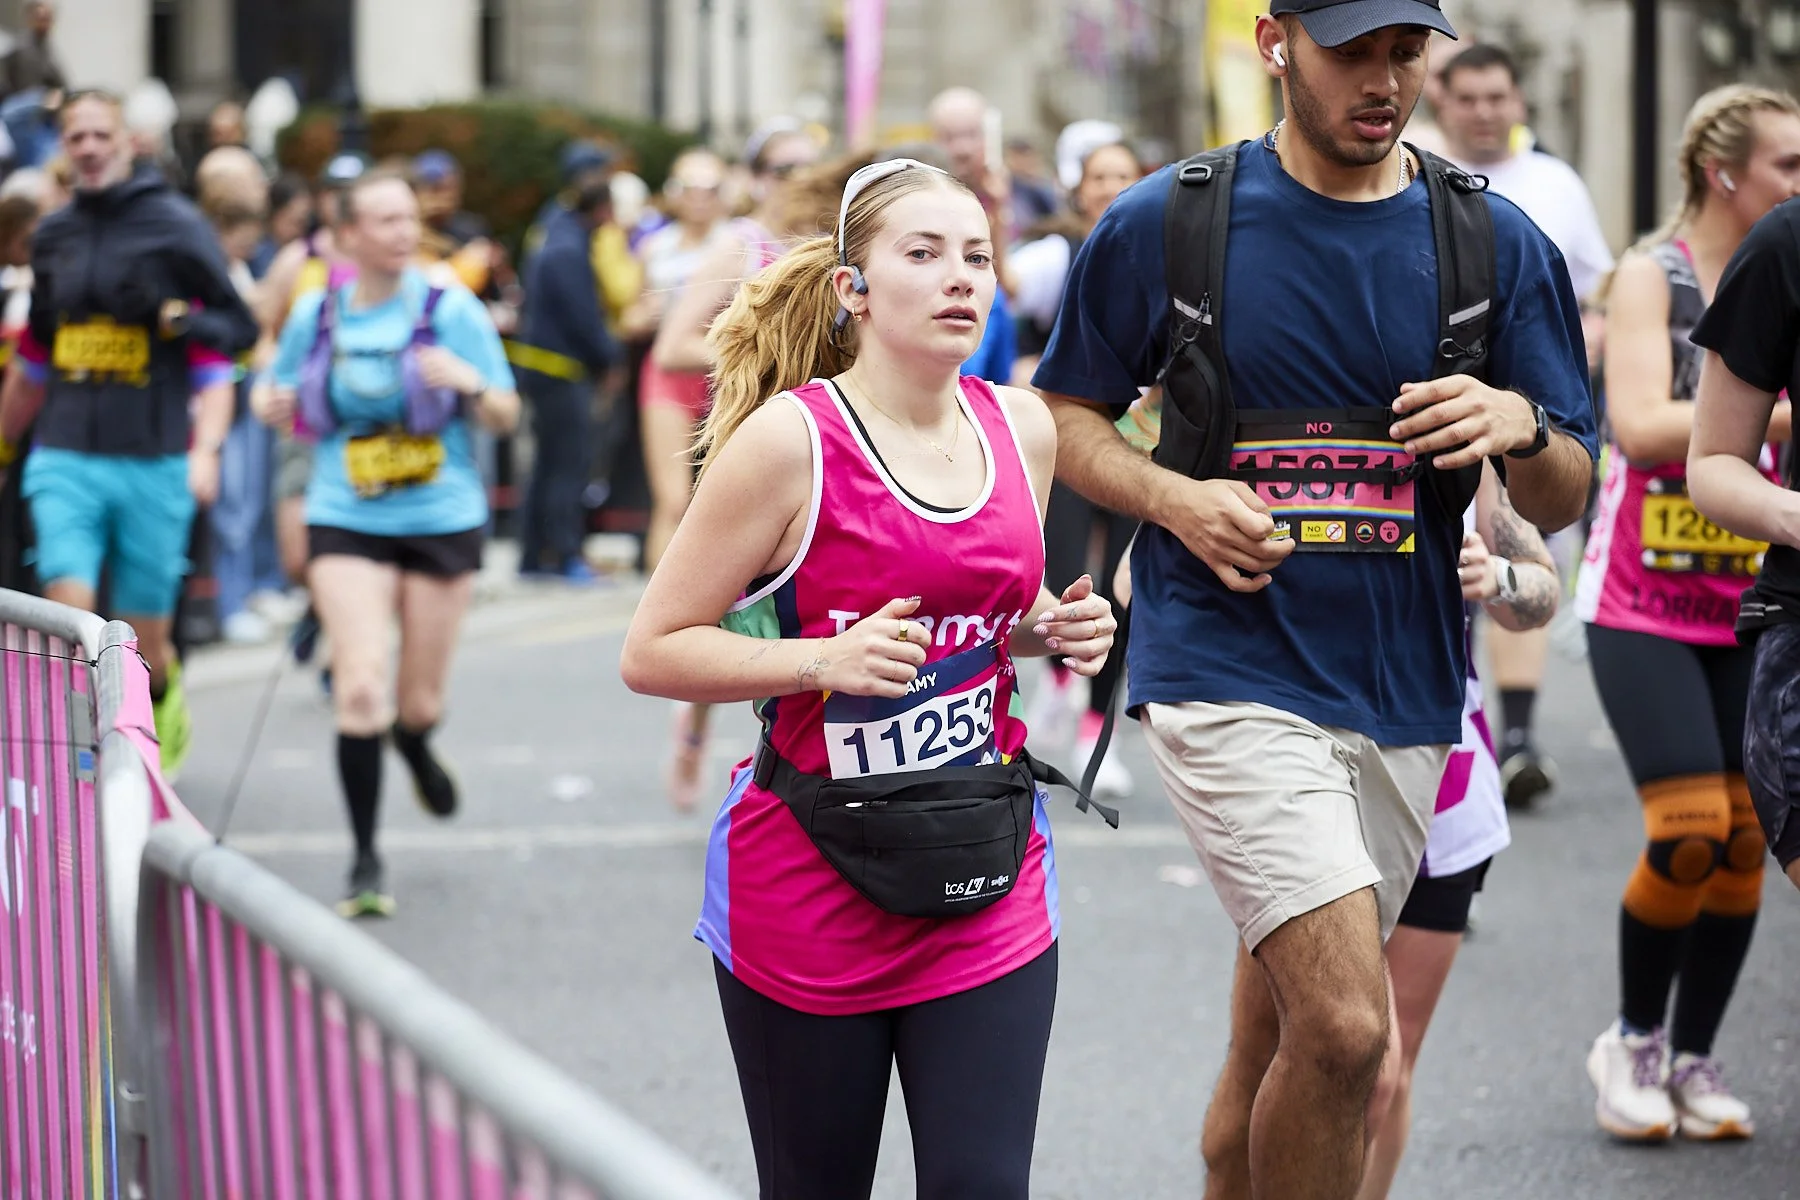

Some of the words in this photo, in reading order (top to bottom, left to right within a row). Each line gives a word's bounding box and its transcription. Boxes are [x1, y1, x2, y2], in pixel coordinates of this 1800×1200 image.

[1306, 422, 1333, 434] NO
[1307, 525, 1321, 533] NO
[1386, 531, 1393, 540] 6
[905, 672, 937, 696] AMY
[843, 687, 993, 775] 11253
[945, 881, 965, 896] tcs
